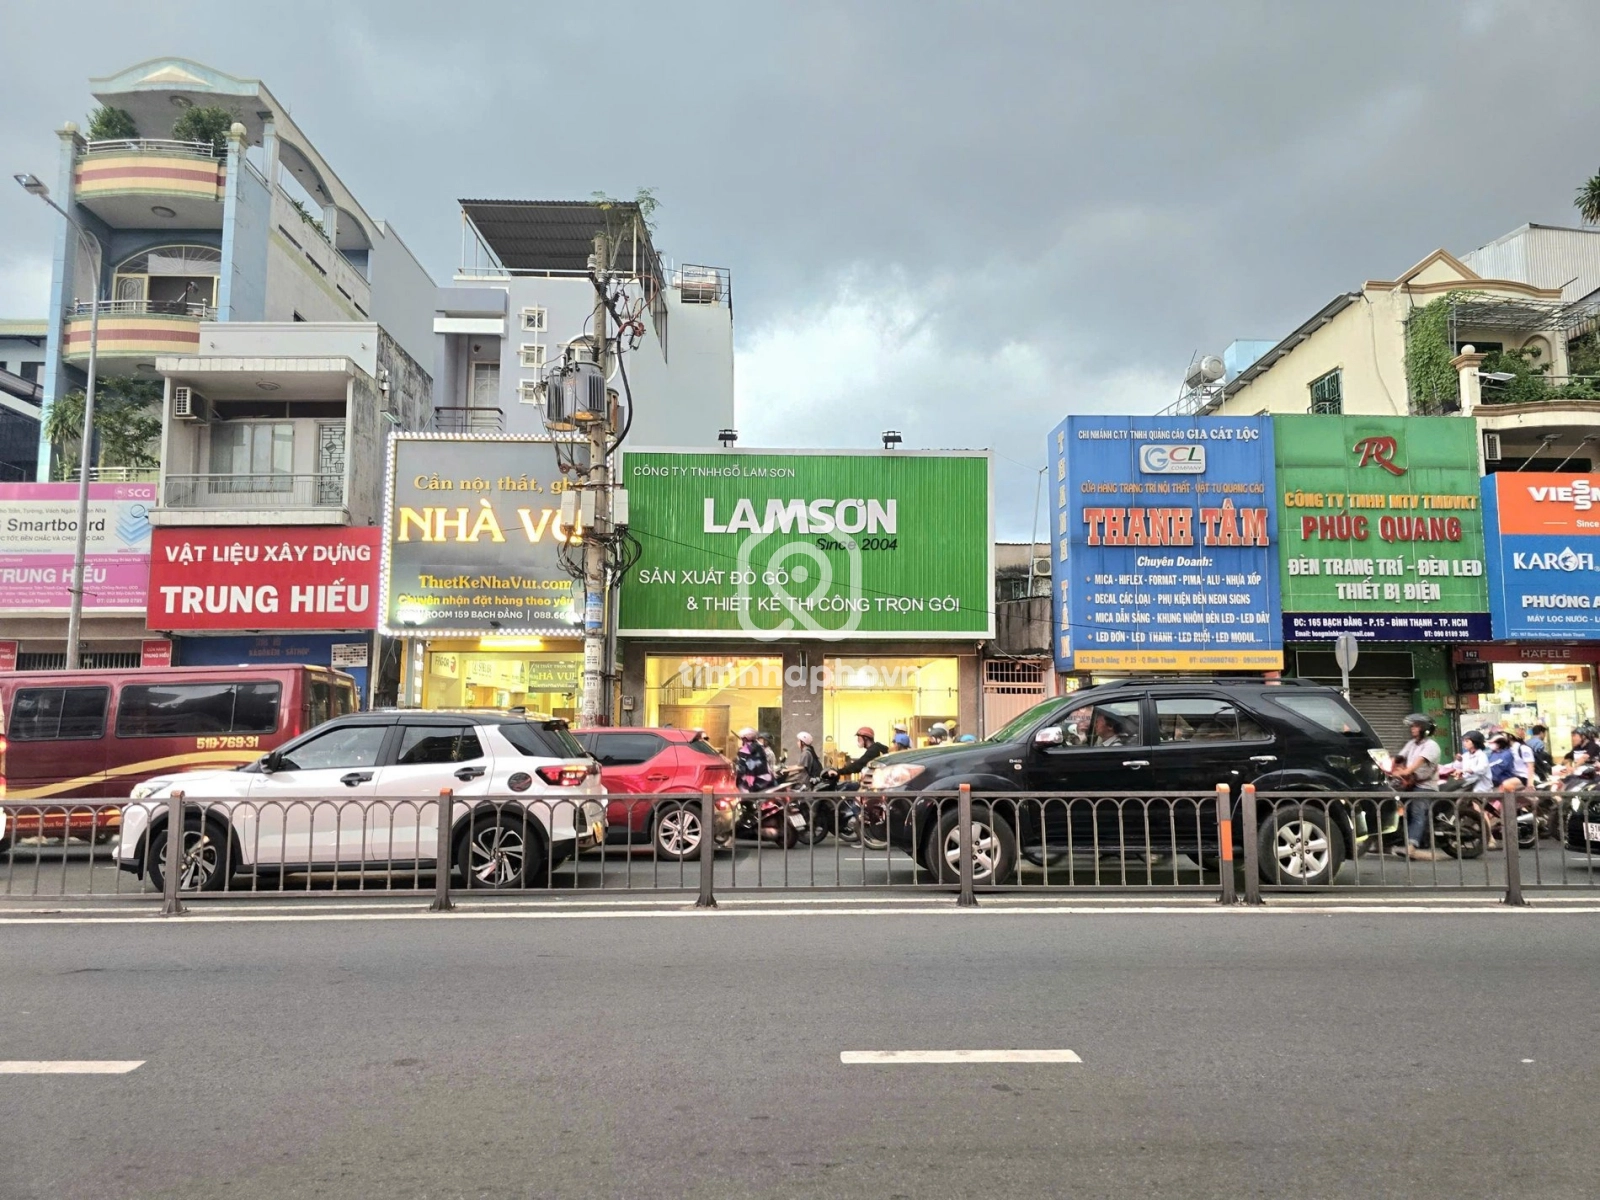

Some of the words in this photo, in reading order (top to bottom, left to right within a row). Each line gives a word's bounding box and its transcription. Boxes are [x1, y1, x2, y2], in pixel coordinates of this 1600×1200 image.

[1078, 430, 1089, 439] CHI
[1090, 428, 1112, 439] NHÁNH
[1113, 430, 1128, 439] C.TY
[1130, 430, 1147, 439] TNHH
[1149, 428, 1170, 440] QUẢNG
[1172, 428, 1185, 439] CÁO
[1187, 429, 1208, 440] GIA
[1210, 426, 1233, 440] CÁT
[1236, 426, 1259, 442] LỘC
[633, 464, 669, 476] CÔNG
[672, 467, 687, 476] TY
[691, 467, 721, 476] TNHH
[723, 464, 740, 476] GỖ
[744, 467, 767, 477] LAM
[769, 467, 795, 477] SƠN
[414, 473, 453, 490] Cần
[460, 477, 491, 493] nội
[498, 474, 543, 493] thất,
[1120, 483, 1143, 493] TRANG
[1145, 481, 1157, 493] TRÍ
[1158, 481, 1170, 494] NỘI
[1172, 480, 1190, 493] THẤT
[1195, 481, 1209, 494] VẬT
[128, 489, 150, 497] SCG
[1284, 489, 1323, 508] CÔNG
[1326, 494, 1344, 508] TY
[1348, 494, 1385, 508] TNHH
[1389, 494, 1419, 509] MTV
[398, 499, 505, 542] NHÀ
[703, 497, 897, 534] LAMSƠN
[1083, 508, 1194, 546] THANH
[1200, 498, 1269, 546] TÂM
[7, 518, 106, 531] Smartbord
[1300, 510, 1369, 541] PHÚC
[1378, 516, 1463, 543] QUANG
[1576, 520, 1600, 528] Since
[816, 539, 856, 551] Since
[862, 539, 898, 551] 2004
[165, 542, 206, 566] VẬT
[212, 542, 258, 566] LIỆU
[263, 542, 308, 562] XÂY
[313, 542, 371, 566] DỰNG
[1137, 556, 1174, 567] Chuyên
[1176, 556, 1213, 567] Doanh:
[1288, 554, 1320, 575] ĐÈN
[1323, 559, 1374, 575] TRANG
[1376, 555, 1404, 575] TRÍ
[1417, 555, 1449, 576] ĐÈN
[1453, 560, 1482, 576] LED
[0, 568, 57, 583] RUNG
[62, 563, 107, 583] HẾU
[639, 567, 675, 584] SẢN
[681, 567, 725, 584] XUẤT
[730, 567, 757, 584] ĐỒ
[762, 567, 789, 584] GỖ
[1095, 575, 1113, 585] MICA
[1119, 575, 1143, 585] HIFLEX
[1149, 575, 1177, 585] FORMAT
[1183, 575, 1201, 585] PIMA
[1207, 575, 1220, 585] ALU
[1226, 573, 1245, 587] NHỰA
[1247, 571, 1262, 585] XỐP
[160, 586, 279, 613] TRUNG
[290, 578, 369, 612] HIẾU
[1335, 577, 1380, 599] THIẾT
[1384, 584, 1400, 603] BỊ
[1404, 580, 1441, 603] ĐIỆN
[398, 592, 440, 606] Chuyên
[443, 594, 470, 606] nhận
[472, 594, 492, 607] đặt
[495, 593, 523, 606] hàng
[525, 594, 551, 605] theo
[553, 594, 574, 607] yêu
[686, 596, 699, 611] &
[702, 593, 753, 611] THIẾT
[758, 593, 781, 611] KẾ
[787, 597, 813, 611] THI
[818, 594, 870, 612] CÔNG
[875, 597, 924, 614] TRỌN
[928, 594, 960, 612] GÓI
[1095, 594, 1117, 604] DECAL
[1119, 592, 1134, 604] CÁC
[1135, 594, 1151, 606] LOẠI
[1158, 594, 1173, 606] PHỤ
[1174, 591, 1191, 606] KIỆN
[1193, 591, 1207, 604] ĐÈN
[1208, 594, 1228, 604] NEON
[1229, 594, 1251, 604] SIGNS
[1522, 594, 1590, 608] PHƯƠNG
[454, 610, 469, 619] 159
[471, 610, 496, 621] BẠCH
[497, 607, 523, 619] ĐẰNG
[1095, 613, 1114, 623] MICA
[1116, 608, 1130, 623] DẪN
[1132, 611, 1151, 623] SÁNG
[1157, 613, 1182, 623] KHUNG
[1183, 611, 1204, 623] NHÔM
[1205, 610, 1220, 623] ĐÈN
[1221, 613, 1235, 623] LED
[1241, 613, 1254, 623] LED
[1256, 611, 1270, 623] DÂY
[1527, 614, 1544, 622] MÁY
[1565, 614, 1588, 622] NƯỚC
[1294, 618, 1307, 626] ĐC:
[1308, 618, 1321, 626] 165
[1323, 618, 1342, 628] BẠCH
[1343, 616, 1362, 626] ĐẰNG
[1369, 618, 1385, 626] P.15
[1391, 617, 1408, 626] BÌNH
[1409, 619, 1432, 628] THẠNH
[1439, 619, 1451, 627] TP.
[1452, 619, 1468, 627] HCM
[1096, 632, 1109, 642] LED
[1131, 632, 1145, 642] LED
[1149, 632, 1172, 642] THANH
[1179, 632, 1192, 642] LED
[1216, 632, 1229, 642] LED
